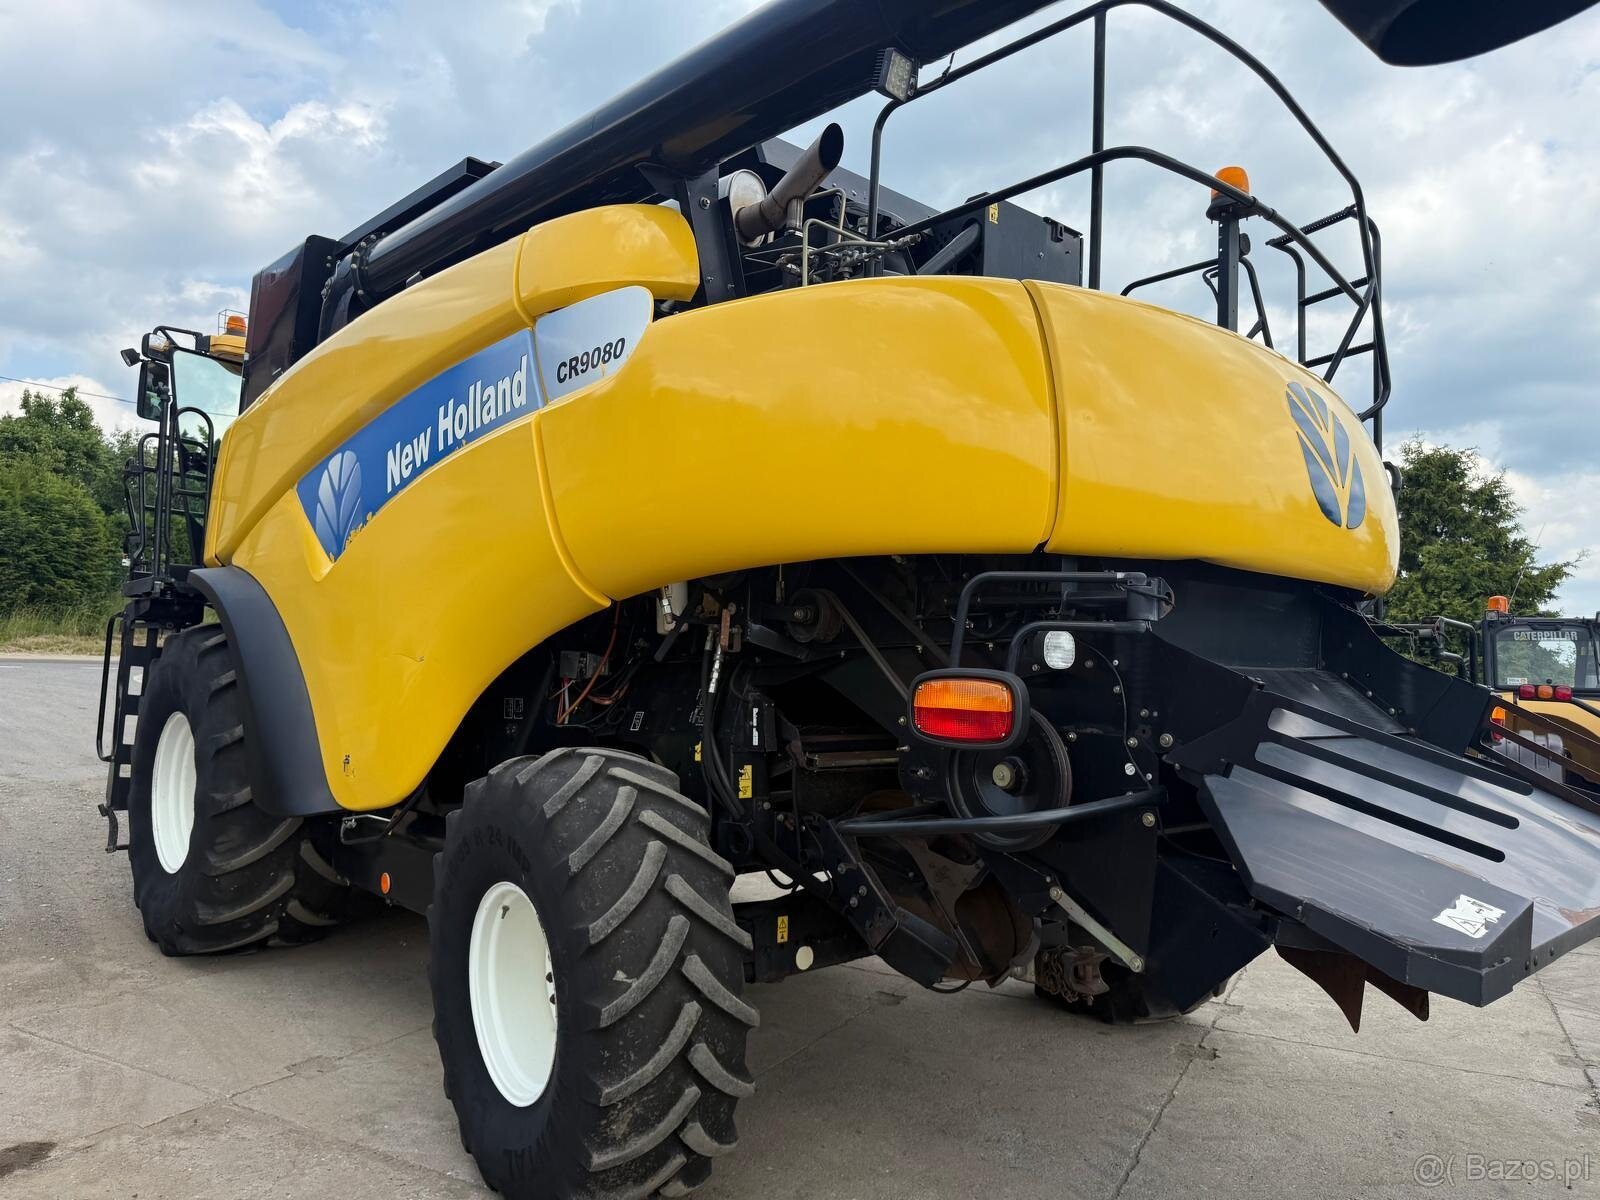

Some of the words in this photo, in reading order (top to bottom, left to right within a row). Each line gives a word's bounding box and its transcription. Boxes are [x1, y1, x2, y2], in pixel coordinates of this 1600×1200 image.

[556, 337, 626, 384] CR9080
[386, 425, 432, 494] New
[438, 354, 528, 452] Holland
[1513, 631, 1578, 641] CATERPILLAR
